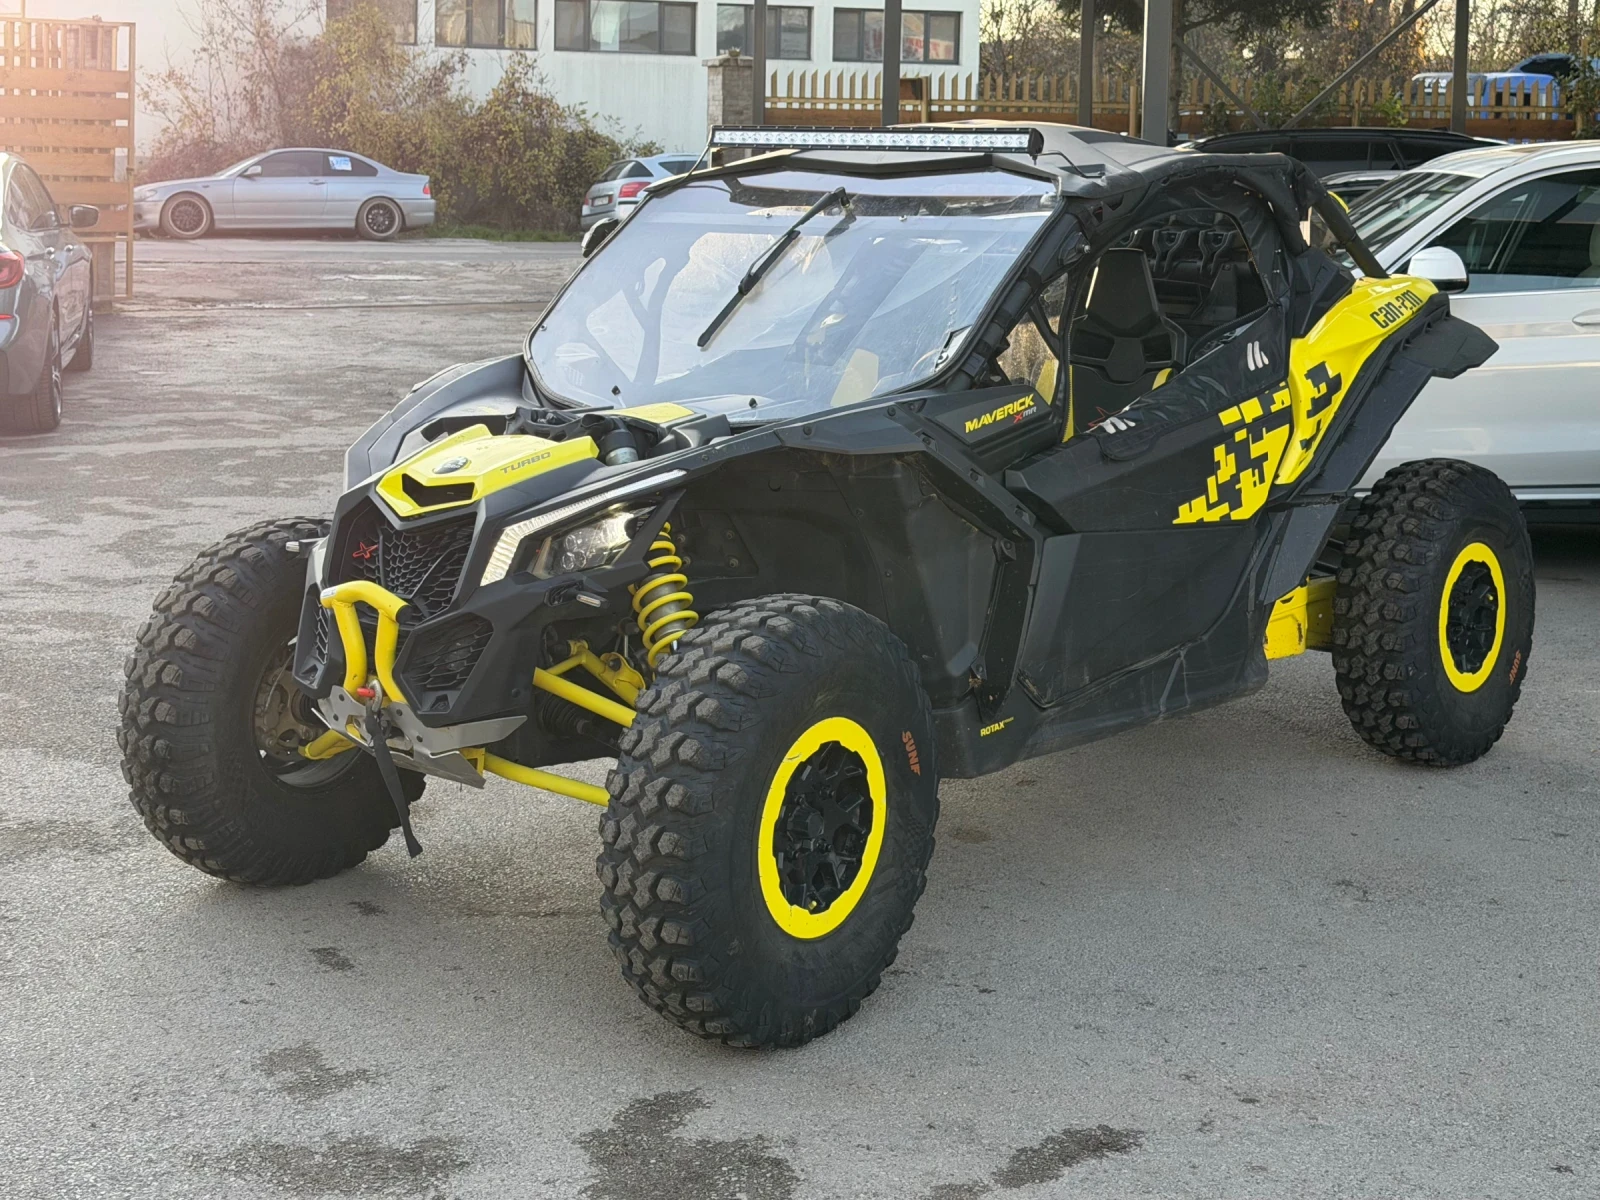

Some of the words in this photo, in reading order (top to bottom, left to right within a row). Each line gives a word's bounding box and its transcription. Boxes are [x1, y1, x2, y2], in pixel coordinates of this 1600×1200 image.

[965, 394, 1035, 433] MAVERICK
[500, 452, 551, 474] TURBO
[980, 721, 1005, 737] ROTAX
[902, 731, 920, 776] SUNF
